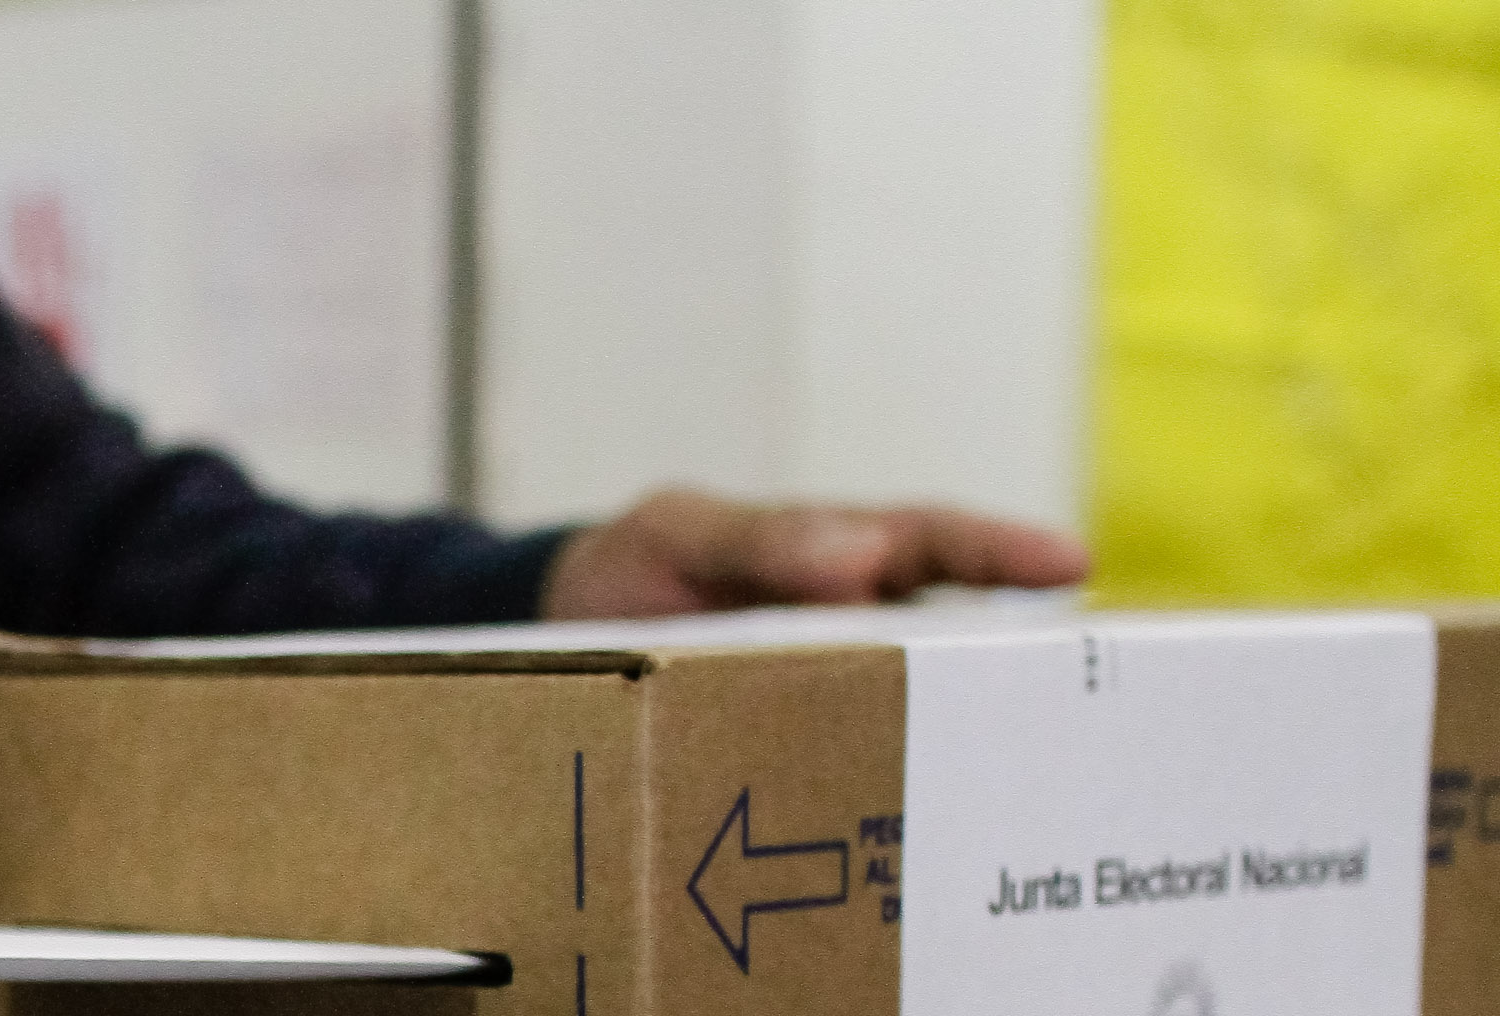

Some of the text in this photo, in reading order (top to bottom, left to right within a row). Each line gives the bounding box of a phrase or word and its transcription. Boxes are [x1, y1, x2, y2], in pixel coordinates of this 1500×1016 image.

[987, 866, 1082, 914] Junta
[1095, 853, 1230, 904] Electoral
[1241, 838, 1369, 890] Nacional
